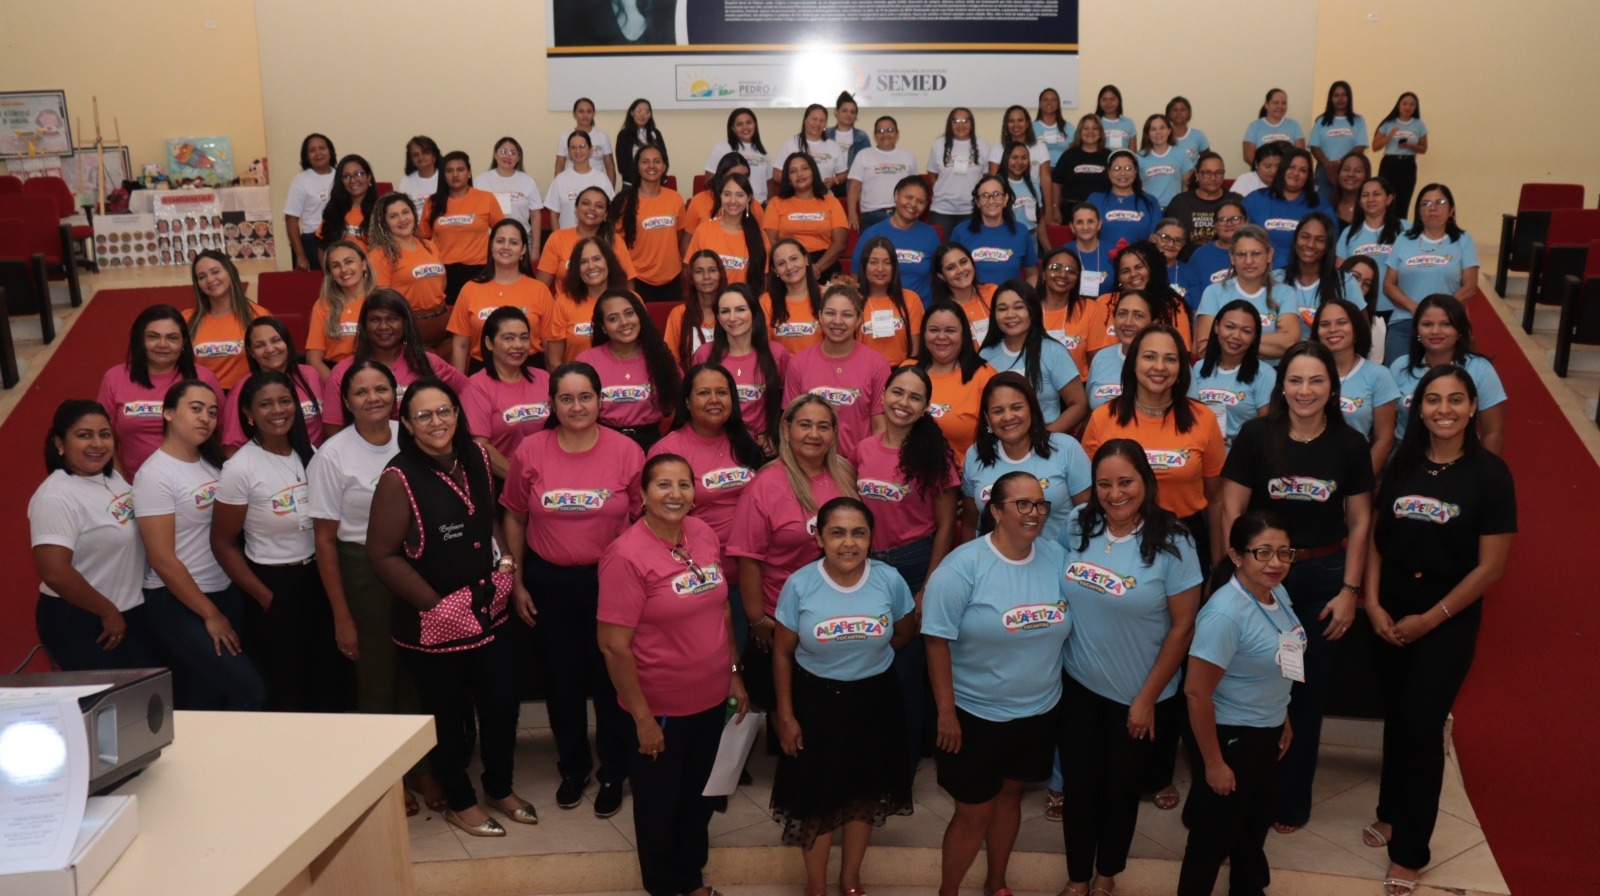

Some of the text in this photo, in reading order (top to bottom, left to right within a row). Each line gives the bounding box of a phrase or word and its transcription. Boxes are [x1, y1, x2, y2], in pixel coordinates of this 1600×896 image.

[739, 85, 770, 94] PEDRO
[877, 74, 947, 91] SEMED
[601, 386, 646, 399] ALFABETIZA
[1146, 453, 1182, 465] BETIZA
[705, 470, 753, 488] ALFABETIZA
[861, 482, 899, 500] FABETIZA
[1271, 481, 1325, 498] ALFABETIZA
[544, 492, 600, 506] ALFABETIZA
[1395, 500, 1445, 520] ALFABETIZA
[1067, 565, 1121, 593] ALFABETIZA
[1078, 580, 1106, 594] TOCANTINS
[1006, 608, 1062, 626] ALFABETIZA
[816, 620, 882, 637] ALFABETIZA
[1023, 622, 1050, 630] TOCANTINS
